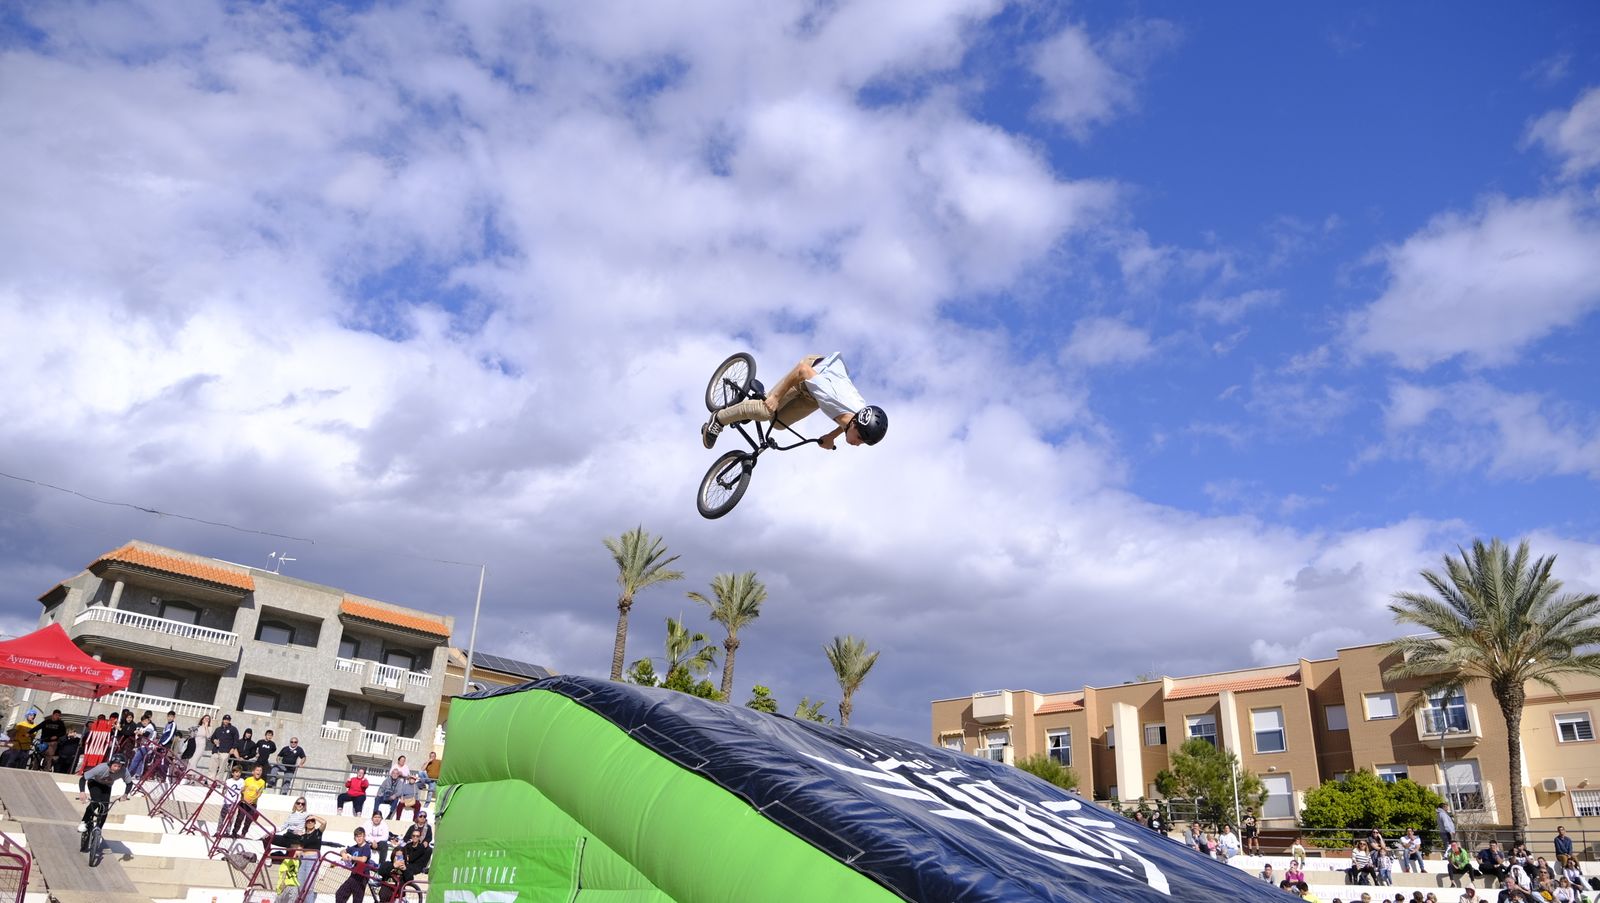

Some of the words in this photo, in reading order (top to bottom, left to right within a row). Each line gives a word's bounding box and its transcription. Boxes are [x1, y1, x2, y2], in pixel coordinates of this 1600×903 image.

[7, 654, 65, 671] Ayuntamiento
[67, 664, 76, 673] de
[80, 665, 101, 676] Vícar
[452, 866, 517, 884] DIRTYBIKE
